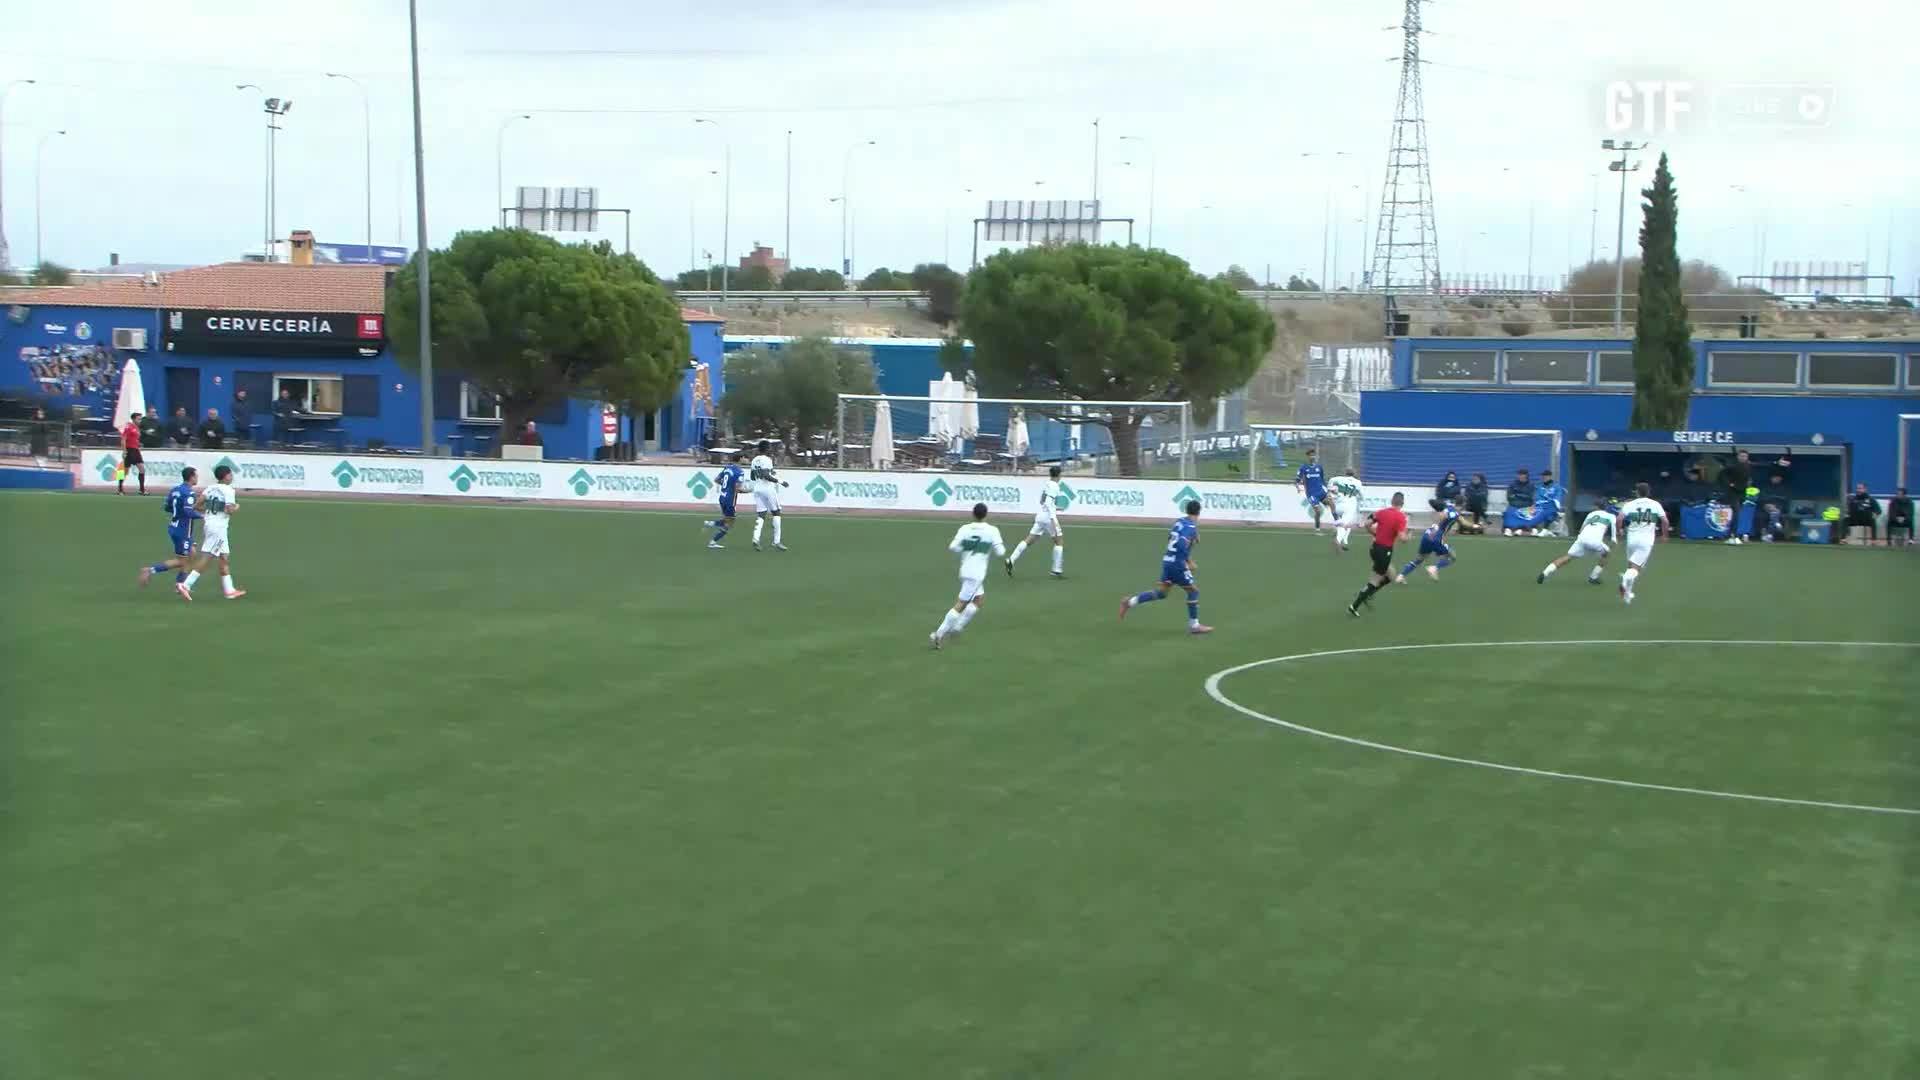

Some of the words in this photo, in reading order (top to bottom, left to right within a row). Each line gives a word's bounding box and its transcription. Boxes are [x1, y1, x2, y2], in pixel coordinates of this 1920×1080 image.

[206, 316, 333, 333] CERVECERÍA
[1673, 431, 1712, 442] GETAFE
[241, 463, 305, 480] TECNOCASA
[359, 467, 424, 484] TECNOCASA
[478, 471, 542, 488] TECNOCASA
[597, 475, 660, 492] TECNOCASA
[833, 482, 898, 499] TECNOCASA
[956, 485, 1020, 502] TECNOCASA
[1077, 489, 1144, 507] TECNOCASA
[1203, 493, 1272, 511] TECNOCASA
[1636, 508, 1652, 524] 14
[1168, 531, 1179, 552] 2
